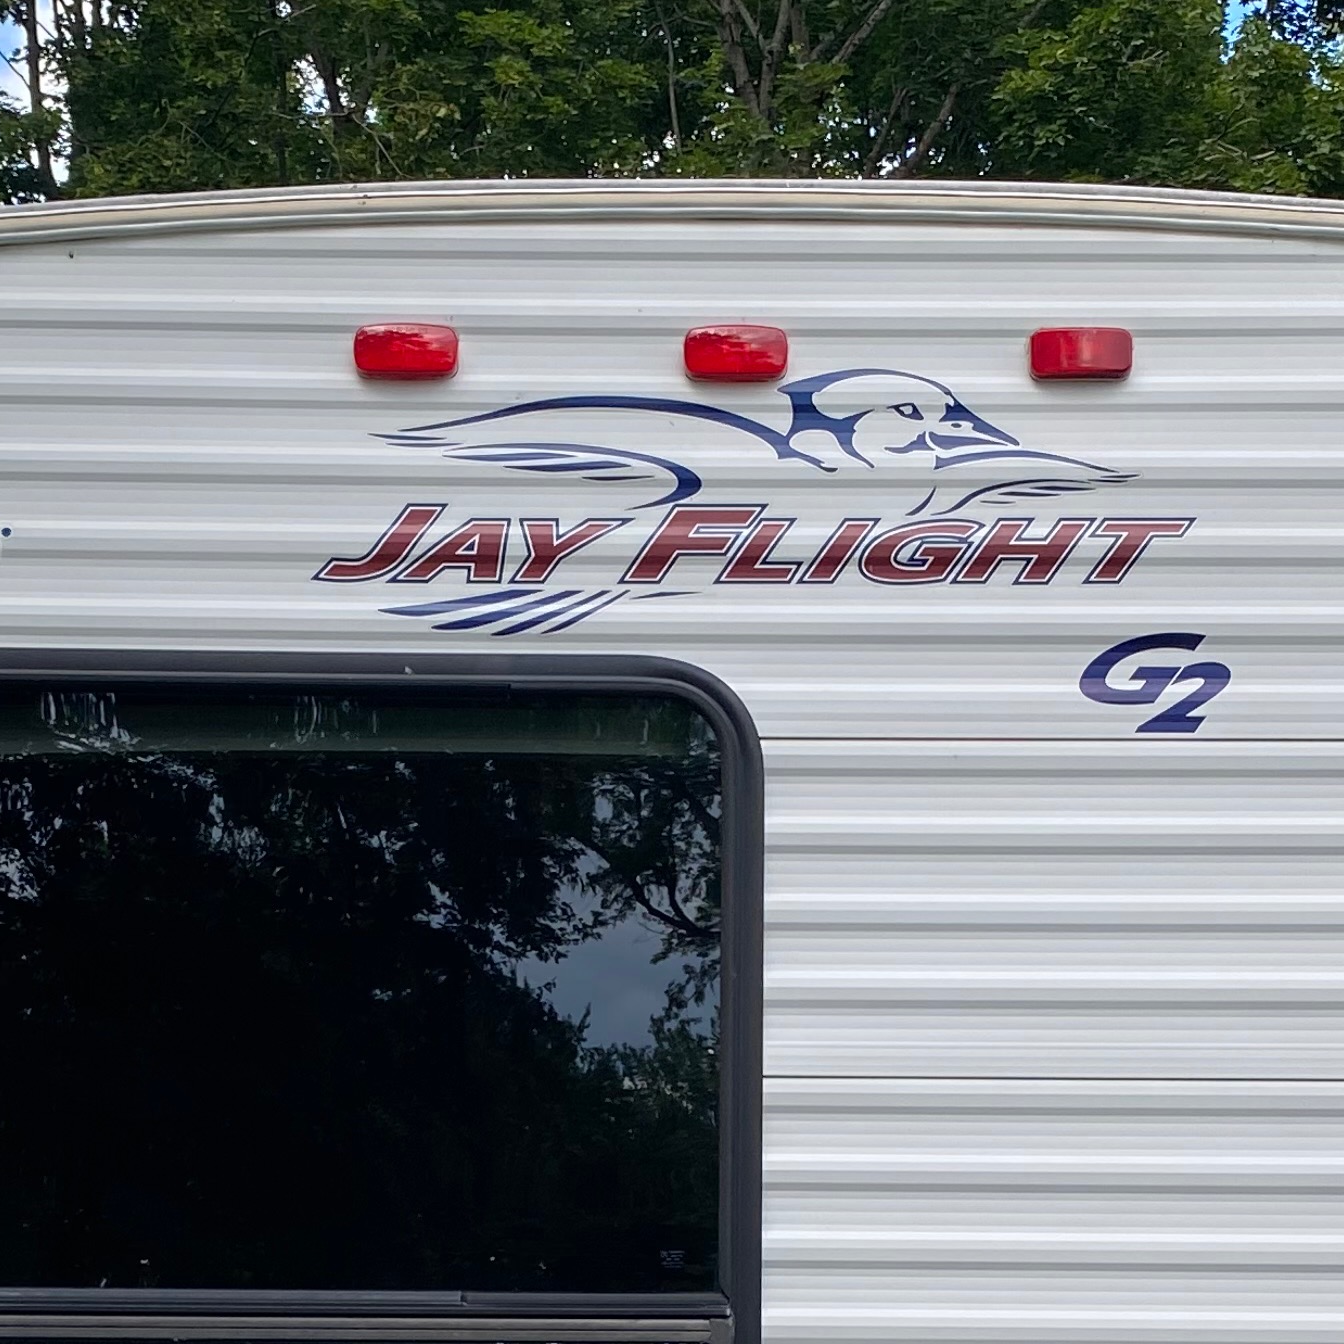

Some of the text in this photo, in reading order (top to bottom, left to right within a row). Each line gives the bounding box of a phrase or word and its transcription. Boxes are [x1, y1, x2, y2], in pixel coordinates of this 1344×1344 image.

[312, 502, 1197, 586] JAY FLIGHT
[1078, 632, 1232, 734] G2
